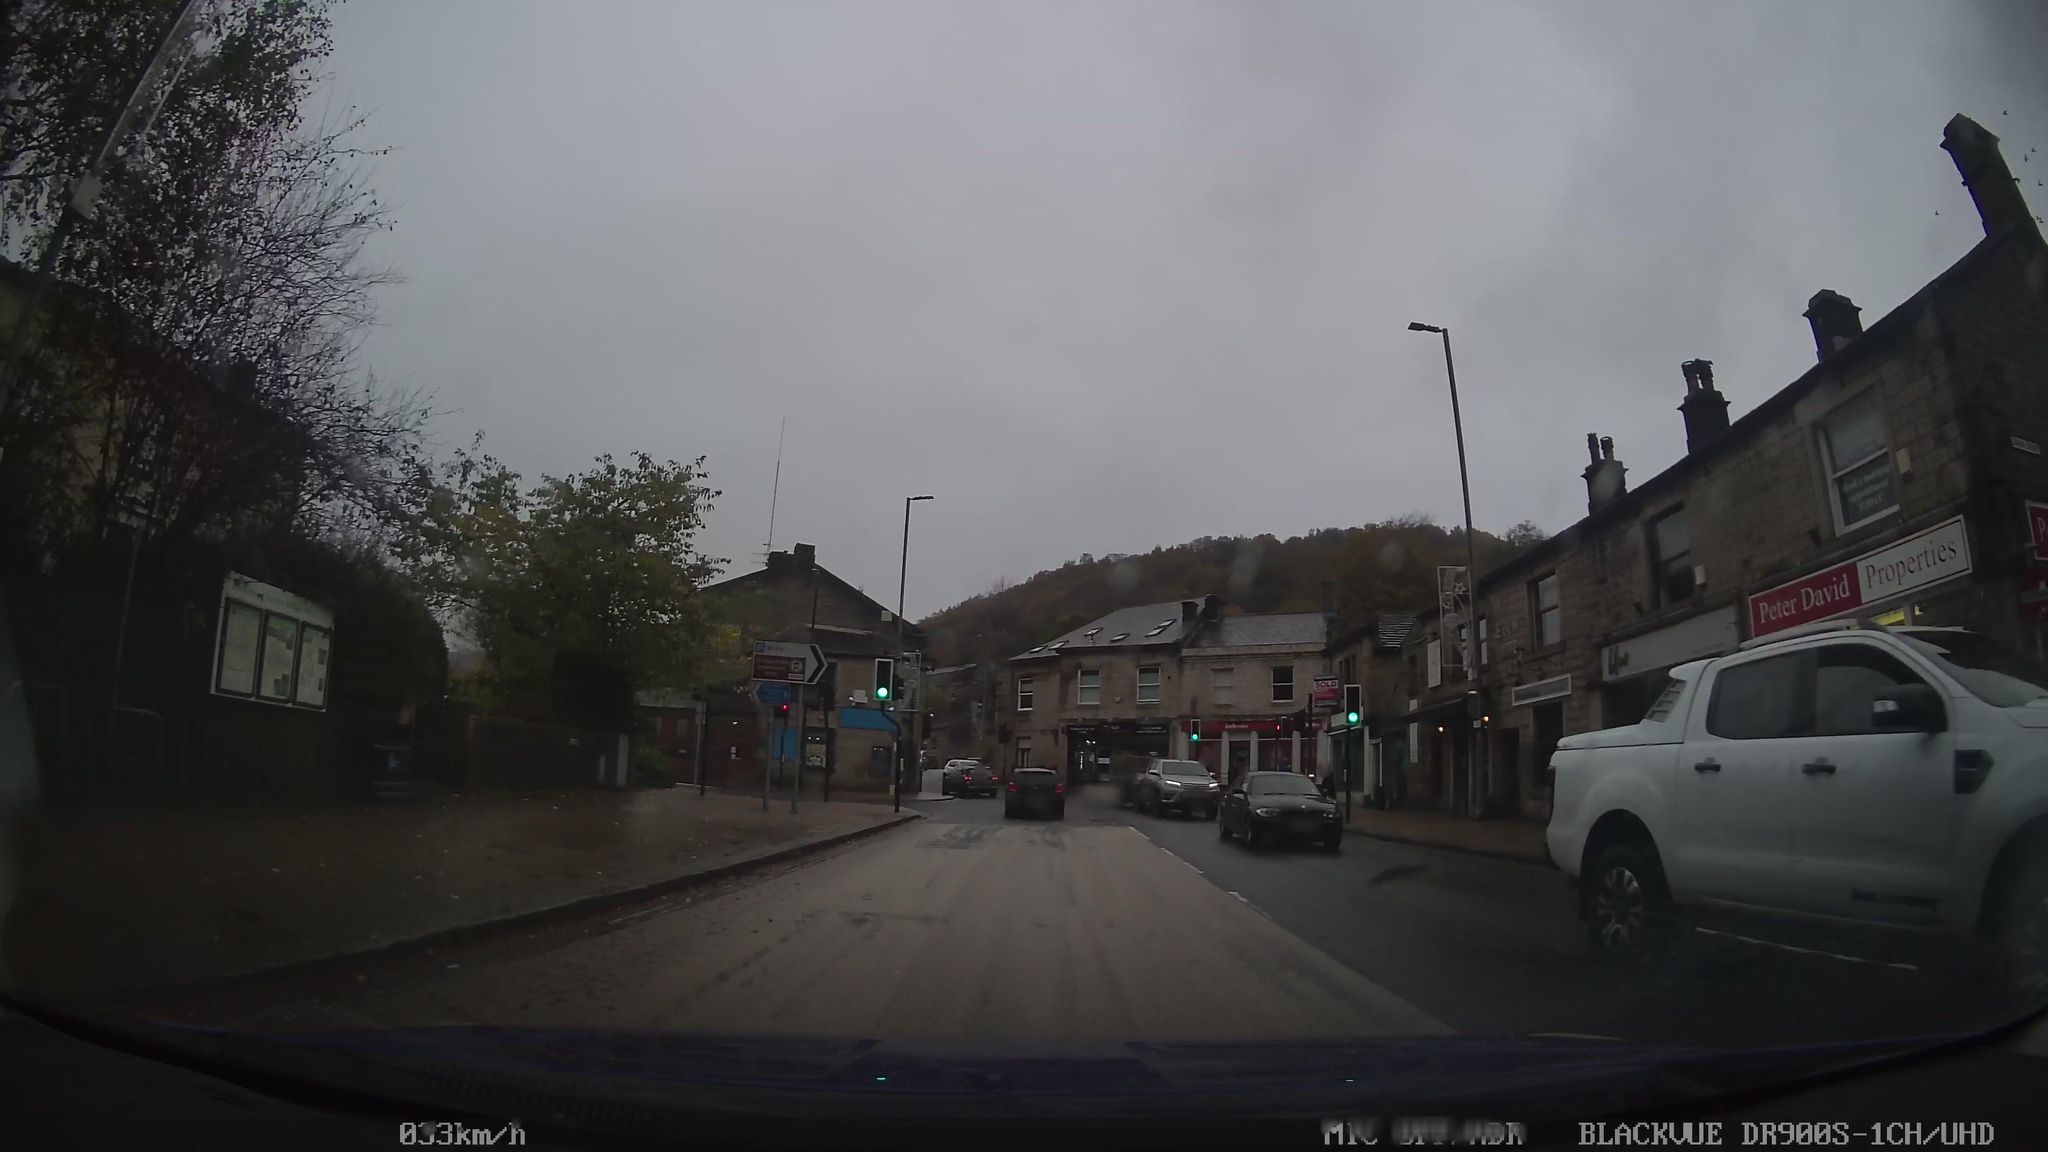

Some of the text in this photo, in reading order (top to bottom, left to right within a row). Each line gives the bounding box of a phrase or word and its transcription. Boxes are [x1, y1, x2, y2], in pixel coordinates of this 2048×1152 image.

[1864, 539, 1957, 589] Properties
[1759, 574, 1851, 624] Peter David
[1315, 680, 1337, 689] SOLD
